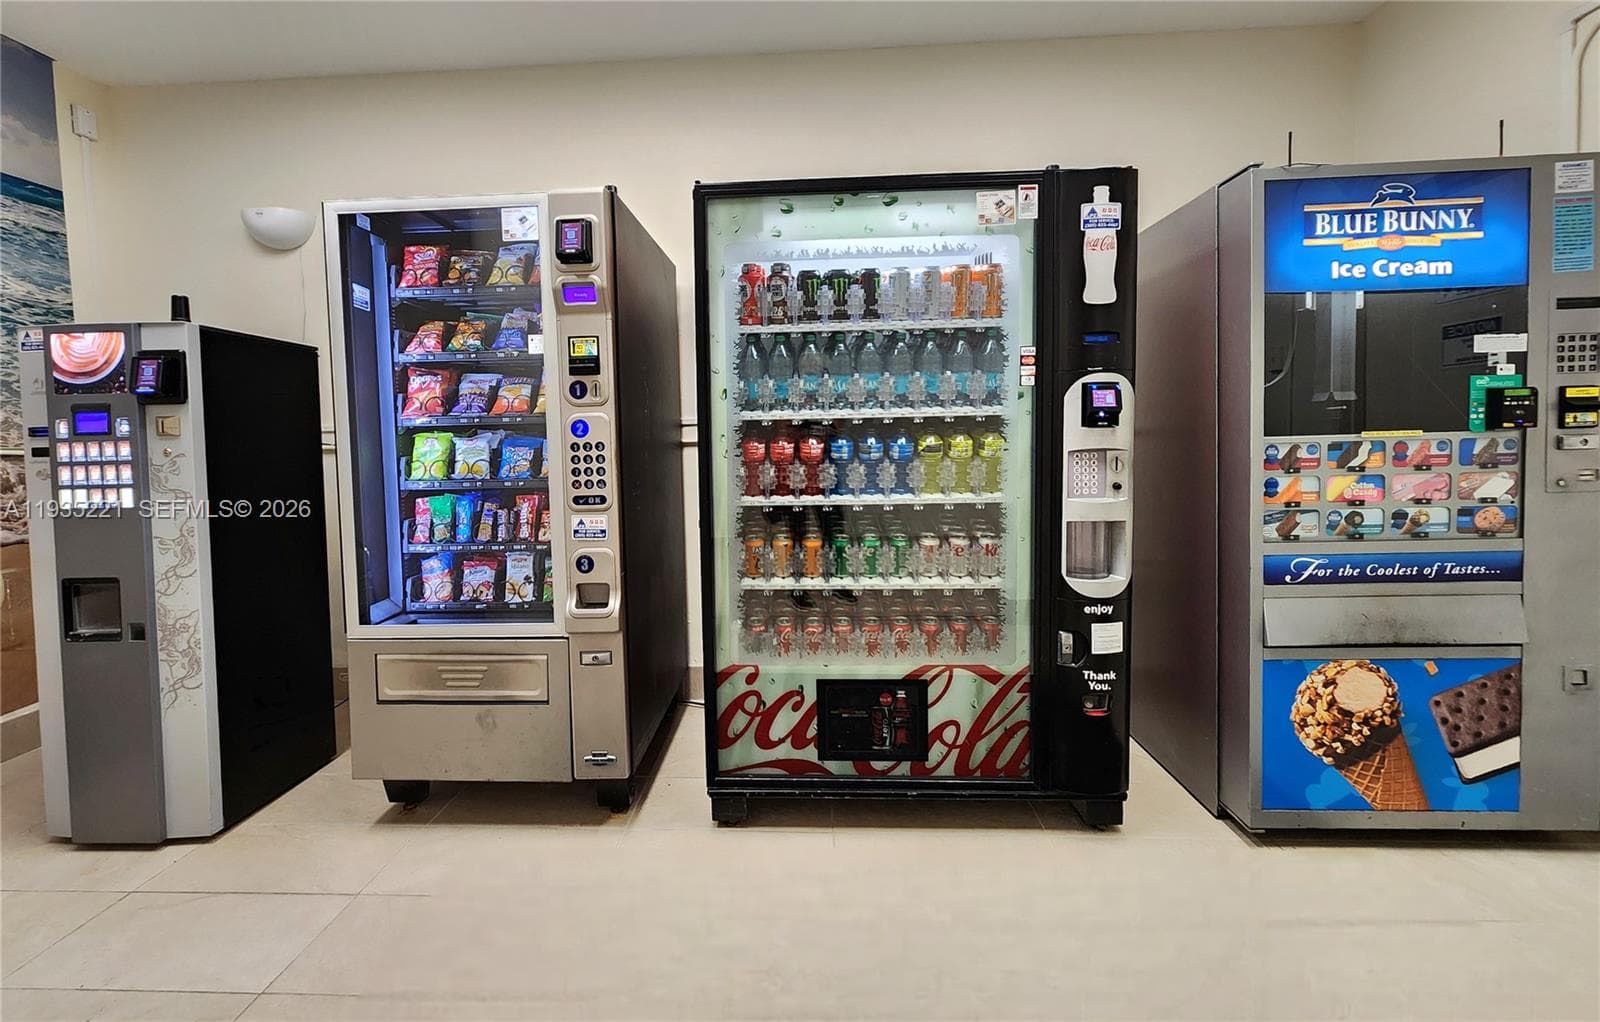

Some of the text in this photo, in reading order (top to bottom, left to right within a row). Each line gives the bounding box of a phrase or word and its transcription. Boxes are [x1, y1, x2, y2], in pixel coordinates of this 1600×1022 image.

[1314, 213, 1378, 235] BLUE
[1331, 259, 1453, 279] Ice Cream
[575, 384, 581, 396] 1
[576, 423, 584, 435] 2
[581, 558, 589, 571] 3
[1285, 557, 1500, 584] For the Coolest of Tastes...
[1083, 604, 1114, 615] enjoy
[1082, 670, 1117, 680] Thank
[1088, 681, 1112, 691] You.
